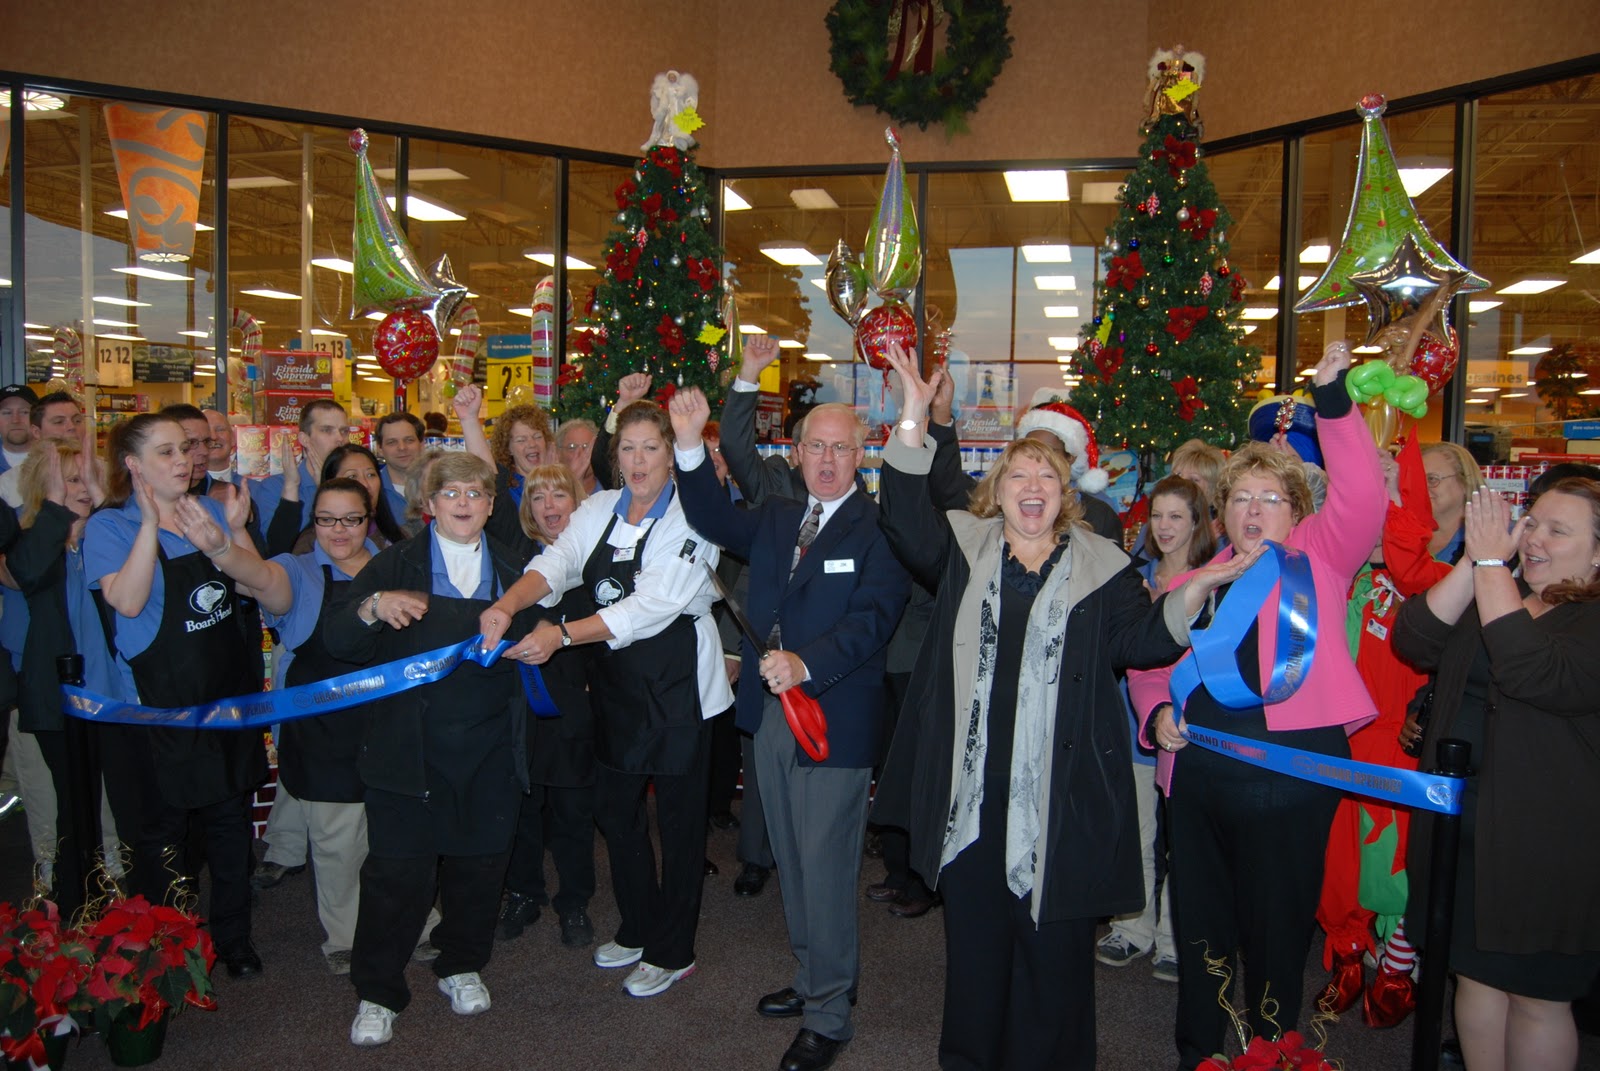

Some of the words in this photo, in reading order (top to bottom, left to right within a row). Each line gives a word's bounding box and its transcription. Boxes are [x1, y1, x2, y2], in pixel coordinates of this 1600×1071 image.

[100, 348, 112, 363] 12
[115, 346, 130, 364] 12
[315, 343, 326, 352] 13
[331, 340, 344, 358] 13
[272, 364, 314, 376] Fireside
[276, 371, 318, 382] Supreme
[1466, 370, 1523, 386] gazines
[502, 365, 512, 399] 2
[275, 405, 305, 416] Fires
[962, 418, 998, 429] Fireside
[1187, 729, 1219, 748] GRAND
[1318, 763, 1352, 782] GRAND
[1353, 771, 1402, 794] OPENING!
